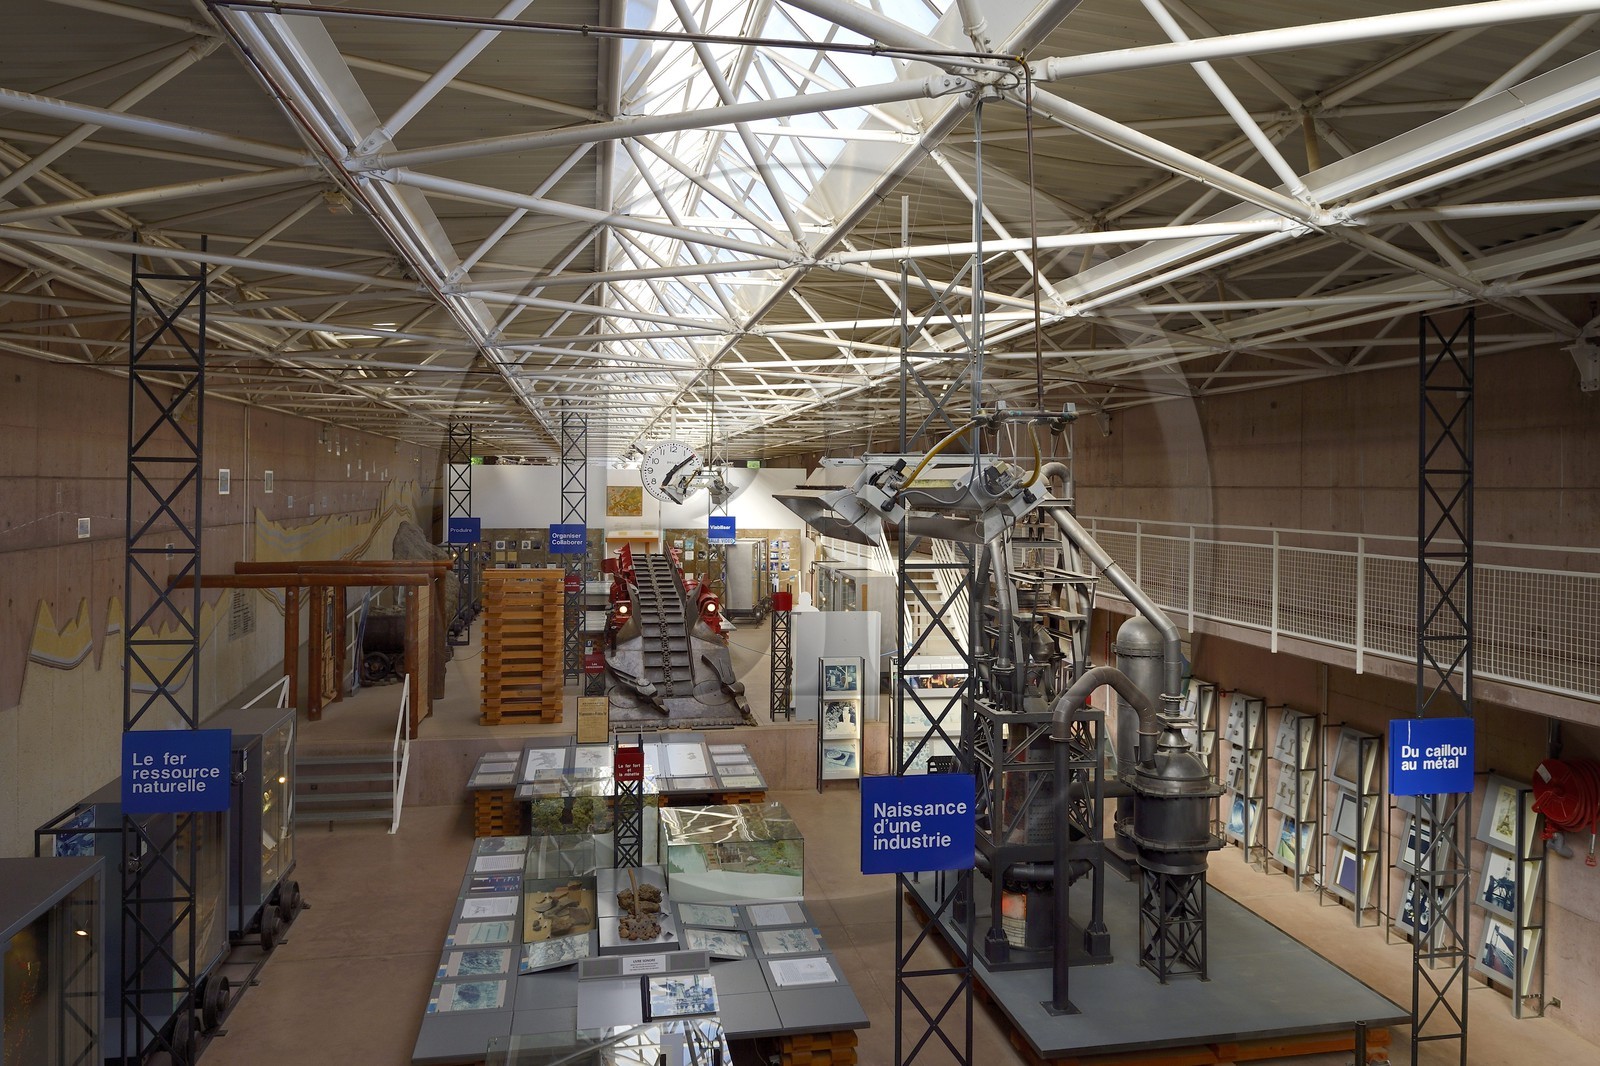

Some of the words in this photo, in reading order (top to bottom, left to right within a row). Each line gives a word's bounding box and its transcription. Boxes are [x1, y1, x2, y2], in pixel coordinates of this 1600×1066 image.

[551, 532, 581, 540] Organiser
[1401, 745, 1419, 758] Du
[1425, 744, 1467, 757] caillou
[132, 752, 154, 766] Le
[163, 752, 187, 765] fer
[1401, 760, 1417, 771] au
[1423, 756, 1459, 770] métal
[132, 767, 220, 780] ressource
[132, 779, 206, 793] naturelle
[873, 802, 967, 818] Naissance
[873, 832, 952, 850] industrie
